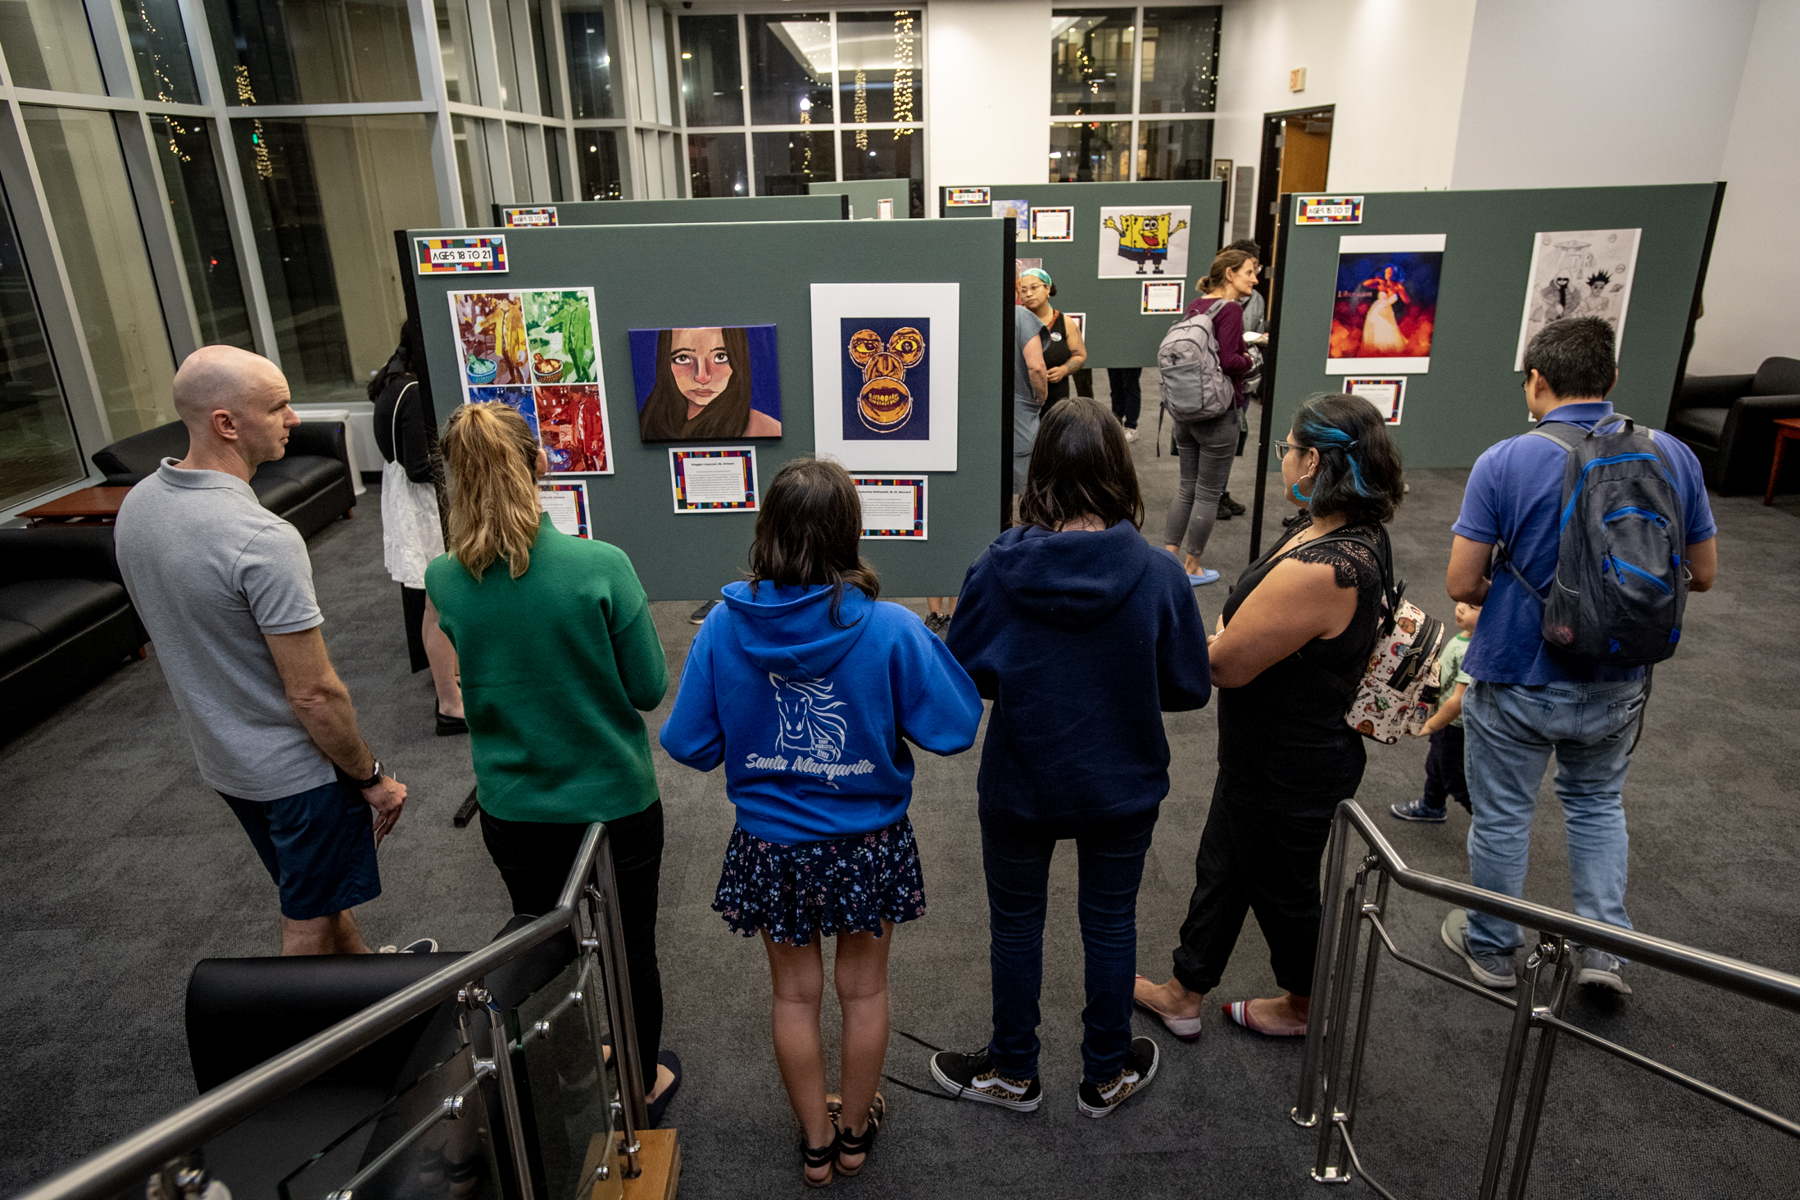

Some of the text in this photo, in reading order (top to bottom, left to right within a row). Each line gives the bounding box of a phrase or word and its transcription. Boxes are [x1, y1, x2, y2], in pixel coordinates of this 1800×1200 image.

[433, 250, 491, 260] AGES 18 TO 21
[745, 753, 876, 781] Santa Margarita
